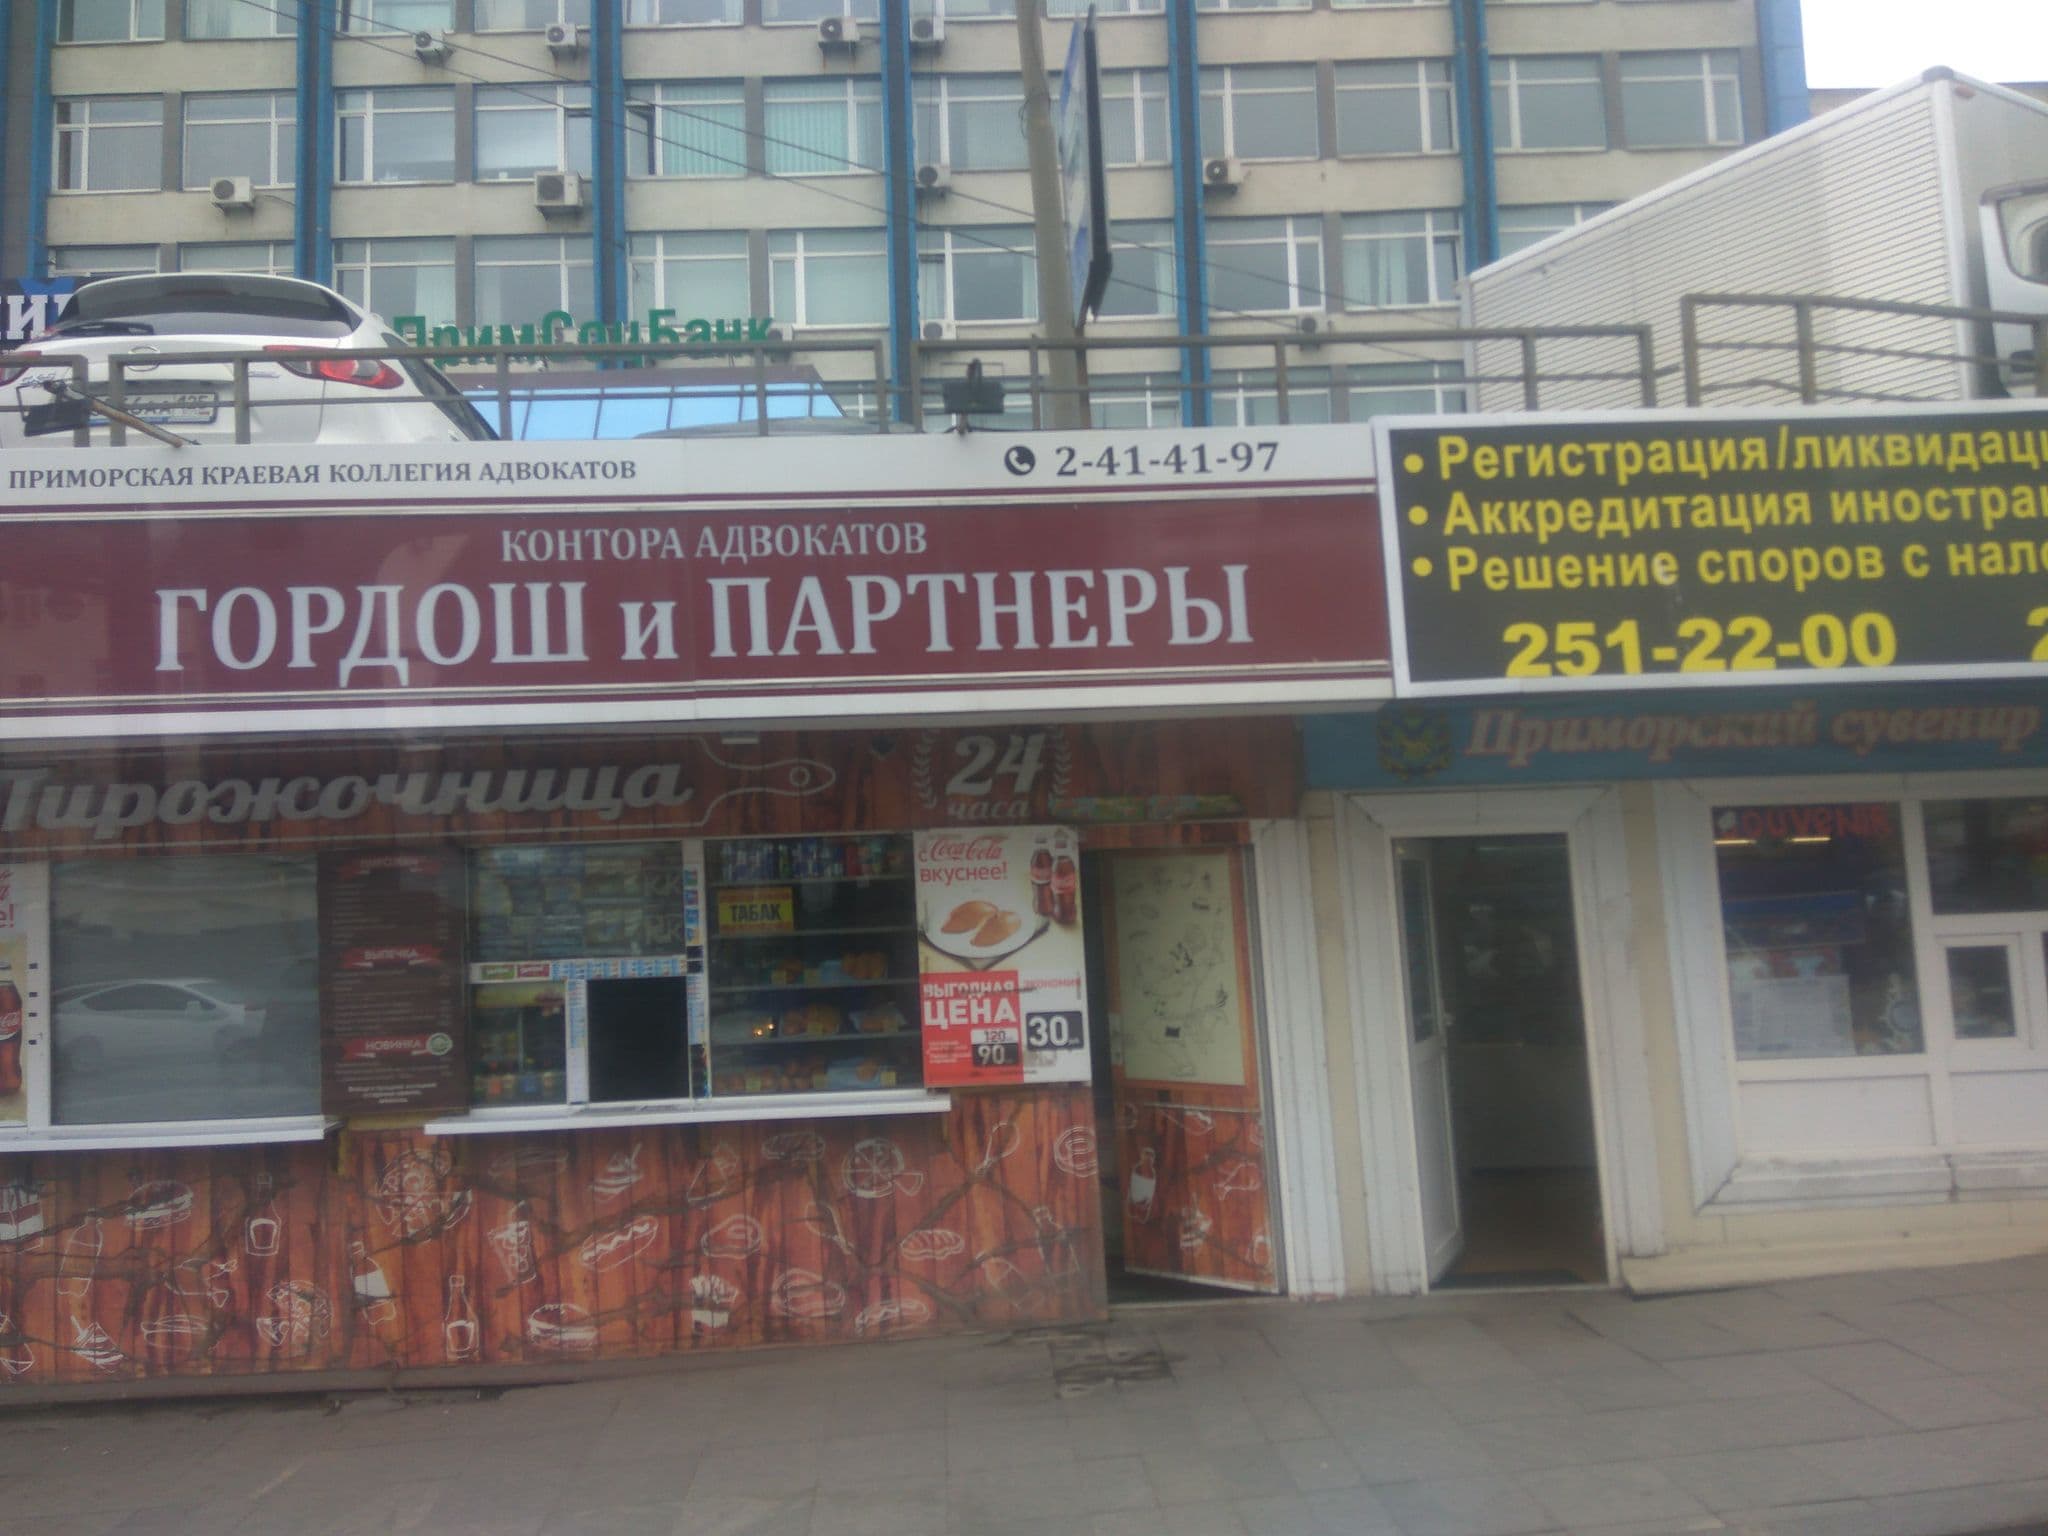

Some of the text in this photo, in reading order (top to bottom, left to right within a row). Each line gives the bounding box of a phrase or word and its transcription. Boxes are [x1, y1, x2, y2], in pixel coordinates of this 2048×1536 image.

[9, 460, 637, 490] ПРИМОРСКАЯ КРАЕВАЯ КОЛЛЕГИЯ АДВОКАТОВ
[1055, 441, 1280, 477] 2-41-41-97
[1443, 490, 1812, 544] Аккредитация
[501, 521, 928, 566] КОНТОРА АДВОКАТОВ
[1446, 546, 1680, 593] Решение
[1697, 540, 1885, 593] споров
[1902, 543, 1930, 579] с
[154, 564, 1255, 690] ГОРДОШ и ПАРТНЕРЫ
[1502, 610, 1898, 680] 251-22-00
[1465, 702, 2044, 769] Приморский сувенир
[945, 733, 1047, 796] 24
[949, 799, 1033, 820] часа
[919, 861, 1009, 886] вкуснее!
[728, 903, 782, 922] ТАБАК
[923, 996, 1018, 1030] ЦЕНА
[1028, 1015, 1070, 1047] 30
[977, 1044, 1006, 1065] 90
